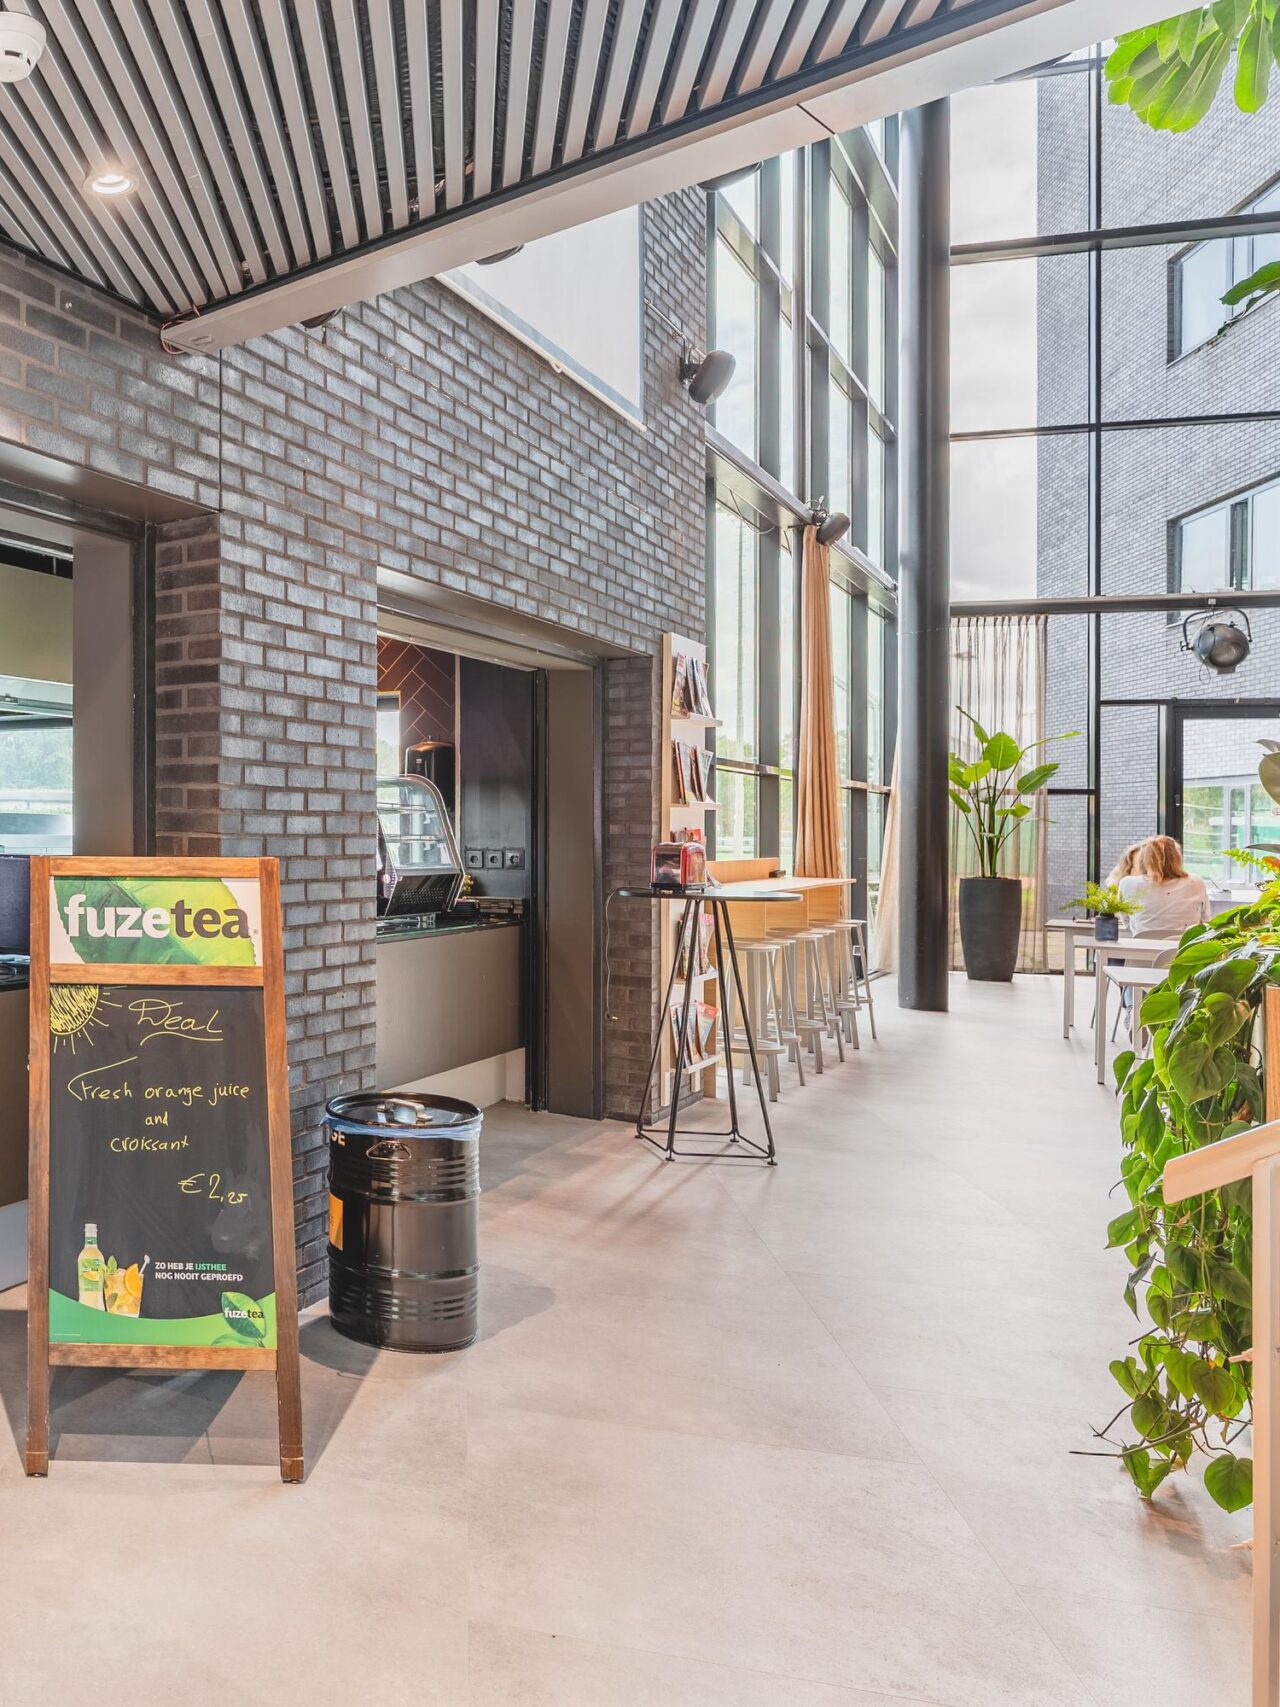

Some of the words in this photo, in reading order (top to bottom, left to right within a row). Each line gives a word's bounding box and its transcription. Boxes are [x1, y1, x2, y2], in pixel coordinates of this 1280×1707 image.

[64, 894, 250, 938] fuzetea
[128, 999, 223, 1033] Deal
[144, 1085, 202, 1106] orange
[208, 1083, 250, 1106] juice
[145, 1111, 169, 1126] and
[154, 1261, 166, 1270] ZO
[167, 1262, 184, 1271] HEB
[185, 1262, 194, 1271] JE
[195, 1263, 227, 1271] IJSTHEE
[154, 1271, 173, 1280] NOG
[174, 1272, 199, 1281] NOOIT
[200, 1273, 243, 1282] GEPROEFD
[224, 1307, 264, 1319] fuzetea
